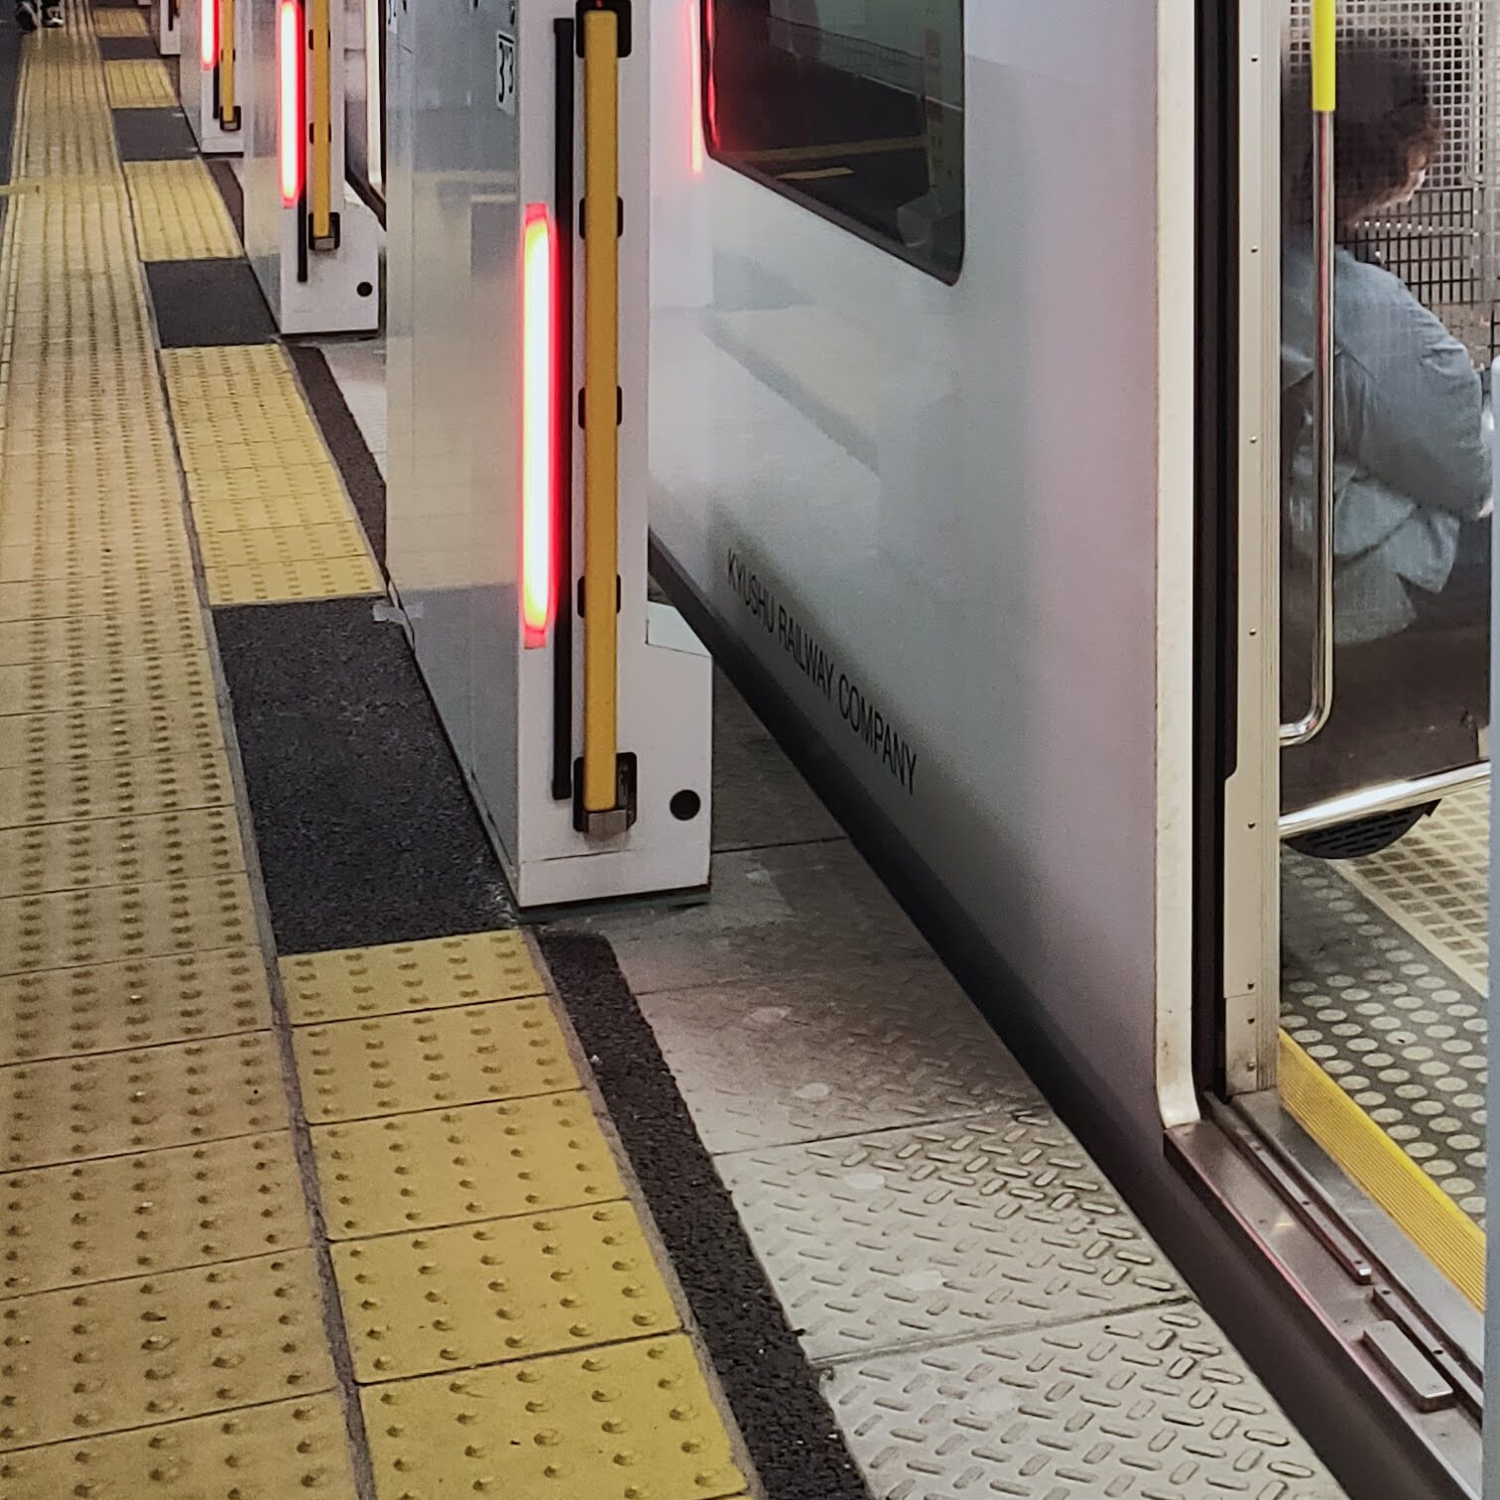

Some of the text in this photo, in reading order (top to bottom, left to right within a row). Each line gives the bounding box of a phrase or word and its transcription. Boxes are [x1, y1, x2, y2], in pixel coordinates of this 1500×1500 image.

[727, 548, 917, 796] KYUSHU RAILWAY COMPANY
